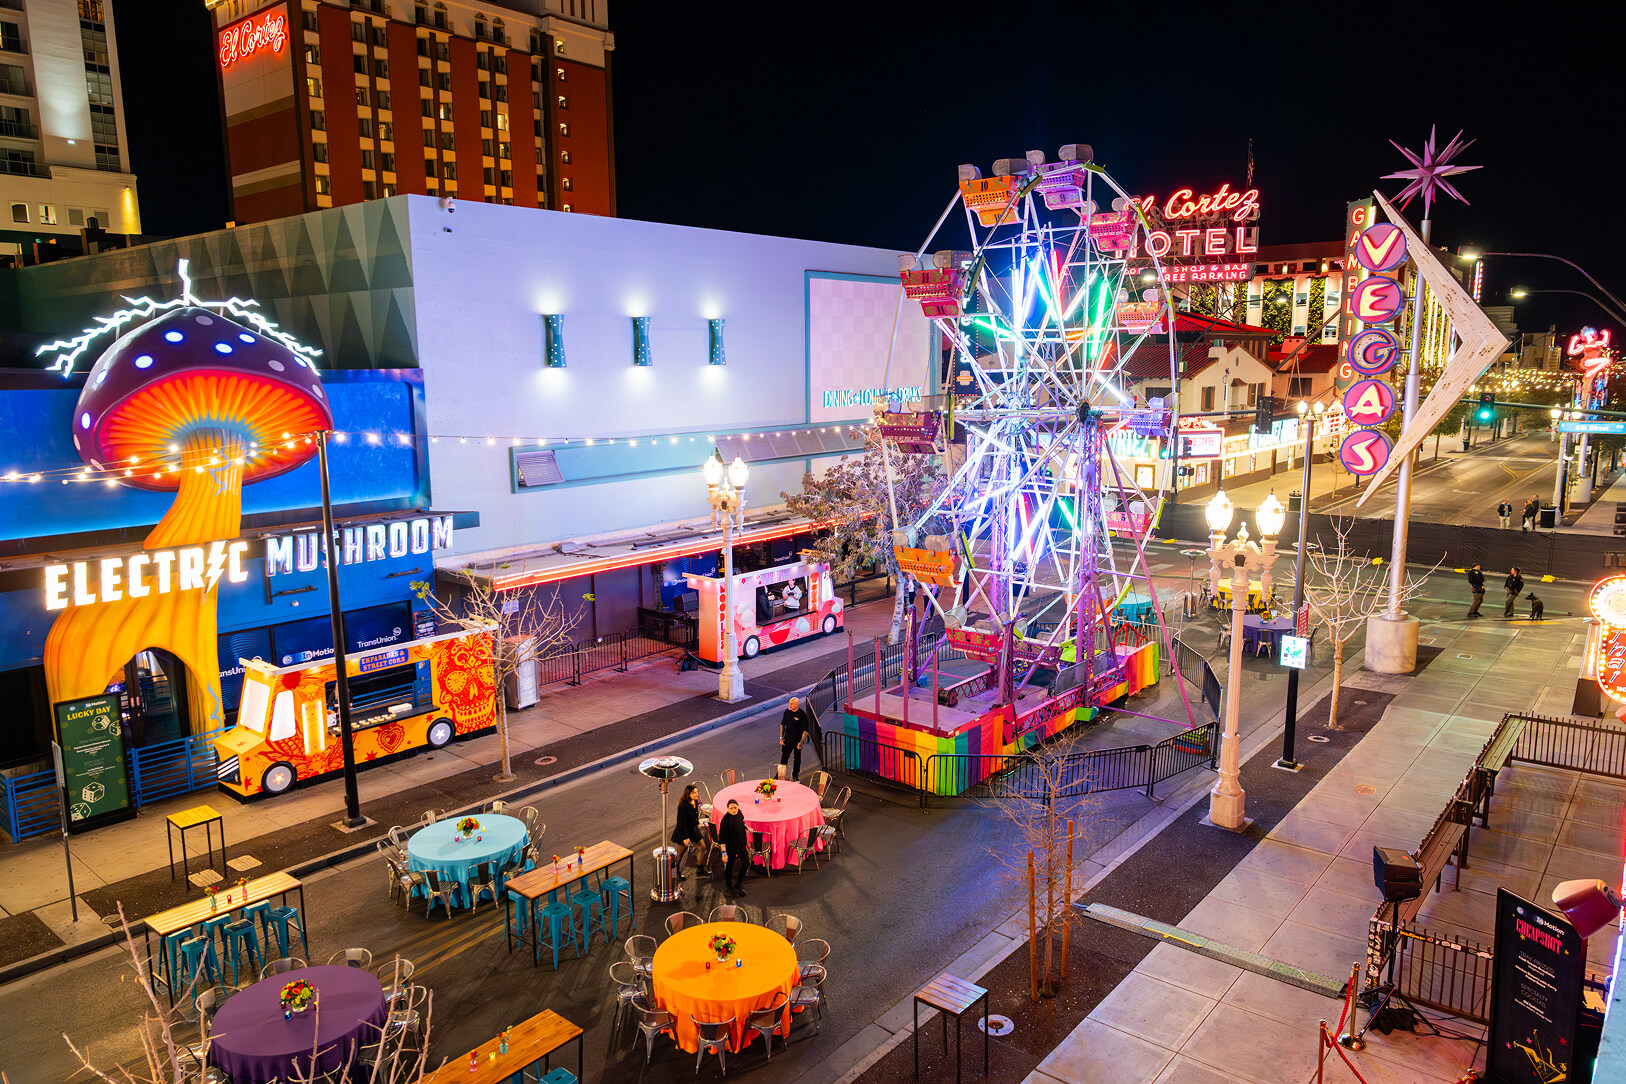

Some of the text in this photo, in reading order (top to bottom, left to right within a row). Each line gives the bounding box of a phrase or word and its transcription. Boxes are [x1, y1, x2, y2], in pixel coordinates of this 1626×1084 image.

[220, 14, 285, 66] El Cortez
[981, 181, 988, 191] 10
[1060, 193, 1066, 203] 9
[1165, 183, 1260, 222] Cortez
[1174, 265, 1205, 273] SHOP
[1192, 271, 1246, 281] PARKING
[1345, 226, 1400, 475] VEGAS
[824, 390, 854, 408] DINING
[860, 388, 891, 406] LOUNE
[1575, 424, 1610, 432] 6th Street
[265, 514, 454, 578] MUSHROOM
[44, 540, 249, 611] ELECTRIC
[357, 635, 397, 649] TransUnion
[361, 650, 399, 665] EMPANADAS
[363, 656, 406, 671] STREET CORN
[67, 705, 111, 721] LUCKY DAY
[1516, 918, 1562, 955] CHEAPSHOT
